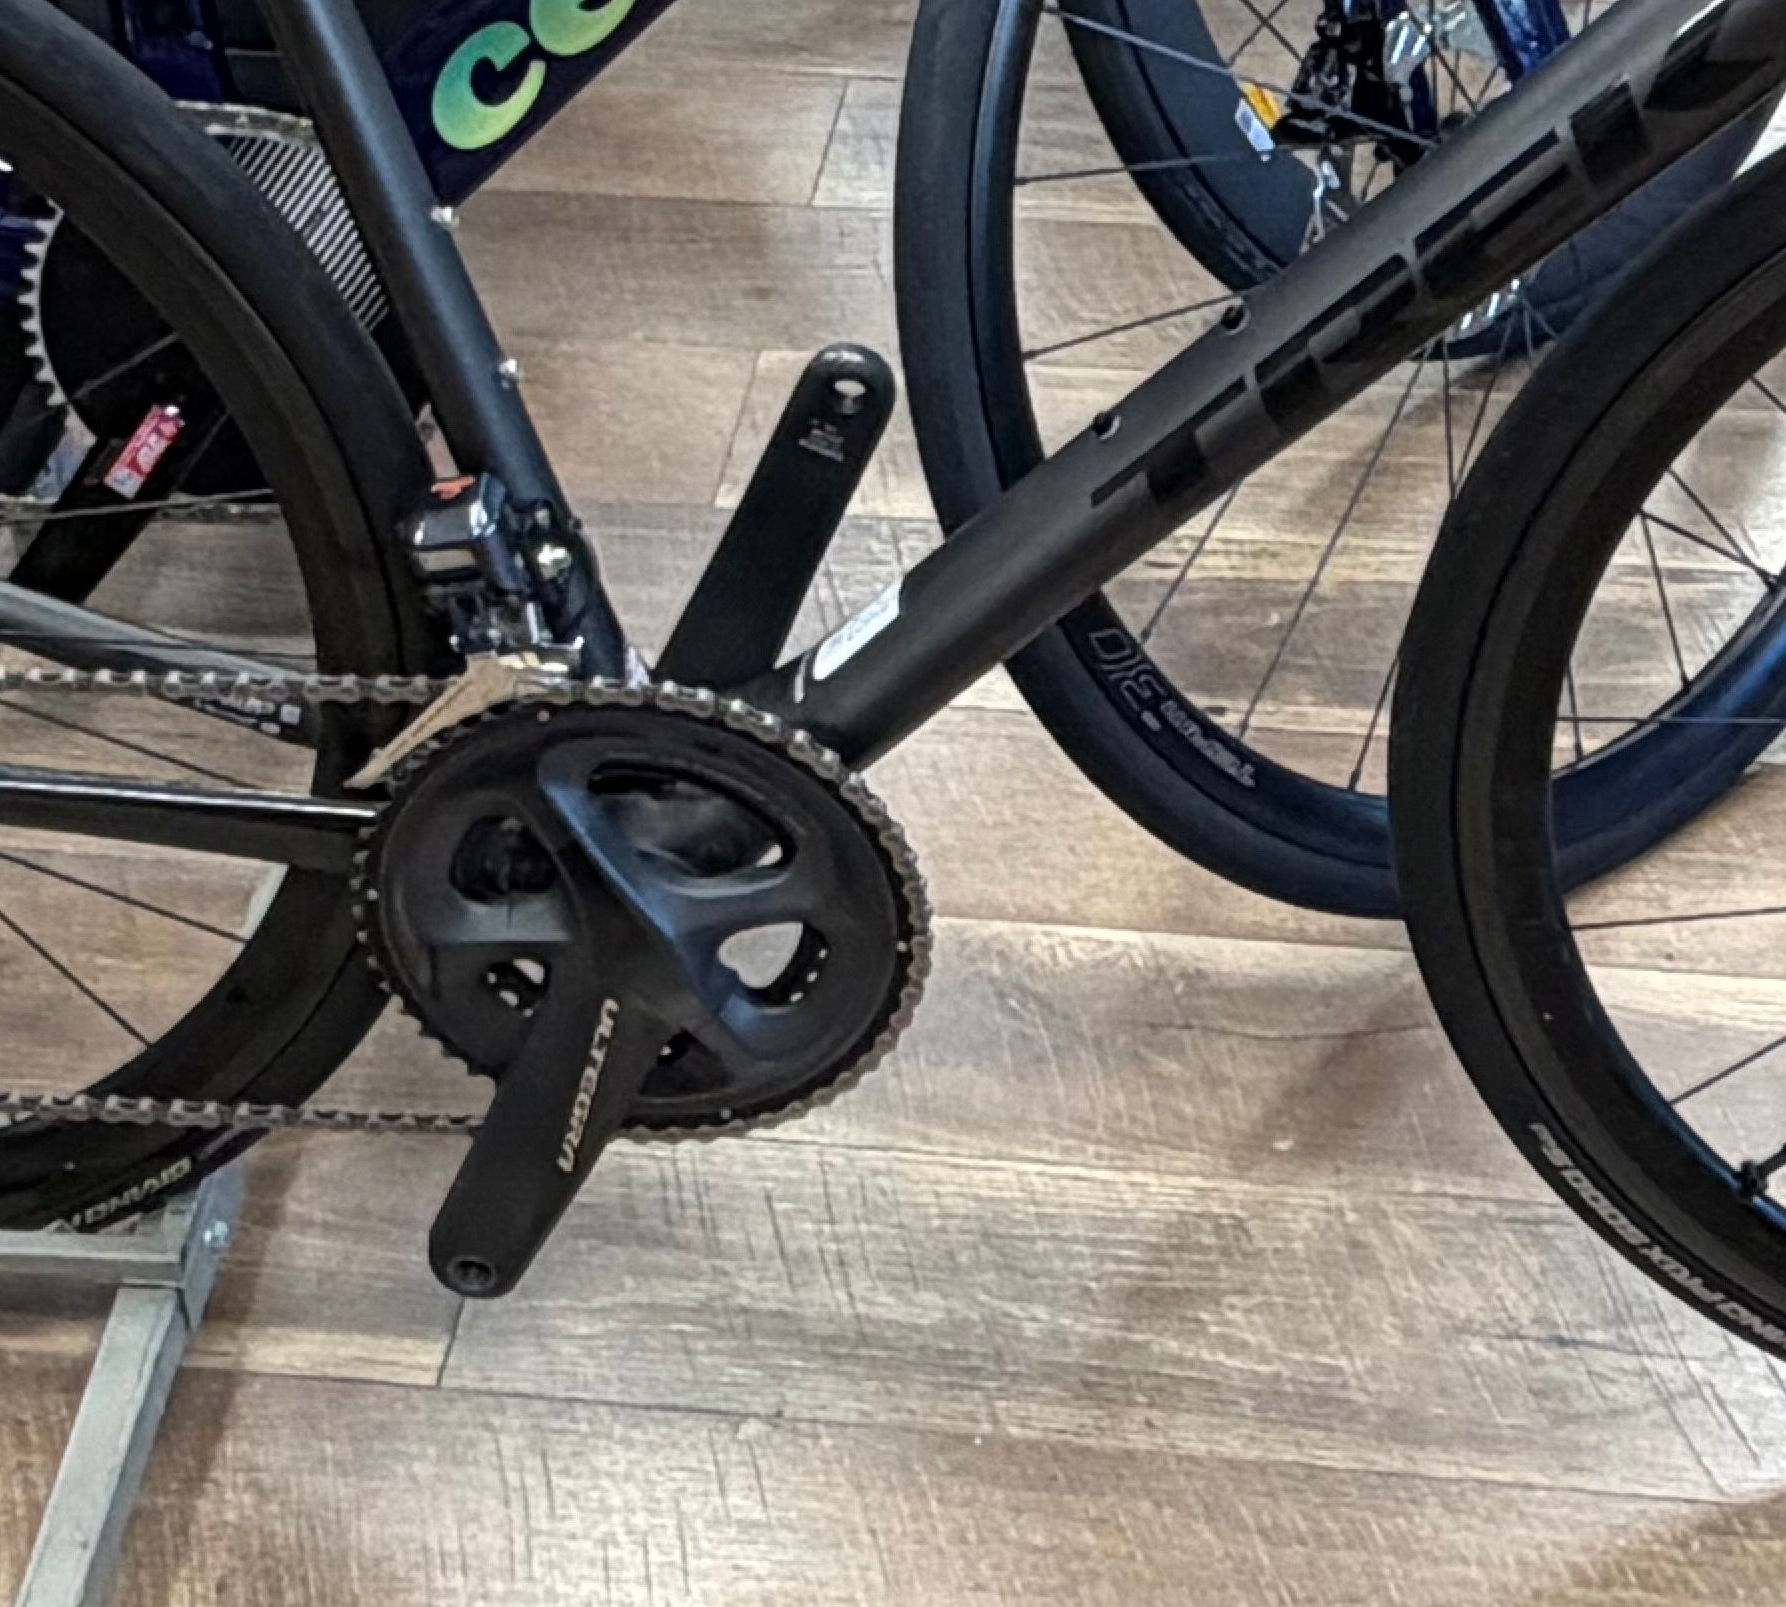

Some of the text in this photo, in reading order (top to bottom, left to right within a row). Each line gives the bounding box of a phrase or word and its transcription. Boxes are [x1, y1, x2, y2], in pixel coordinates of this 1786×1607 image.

[556, 998, 620, 1172] ULTEGRA
[1560, 1168, 1652, 1246] 5000
[1640, 1243, 1726, 1304] PRIX
